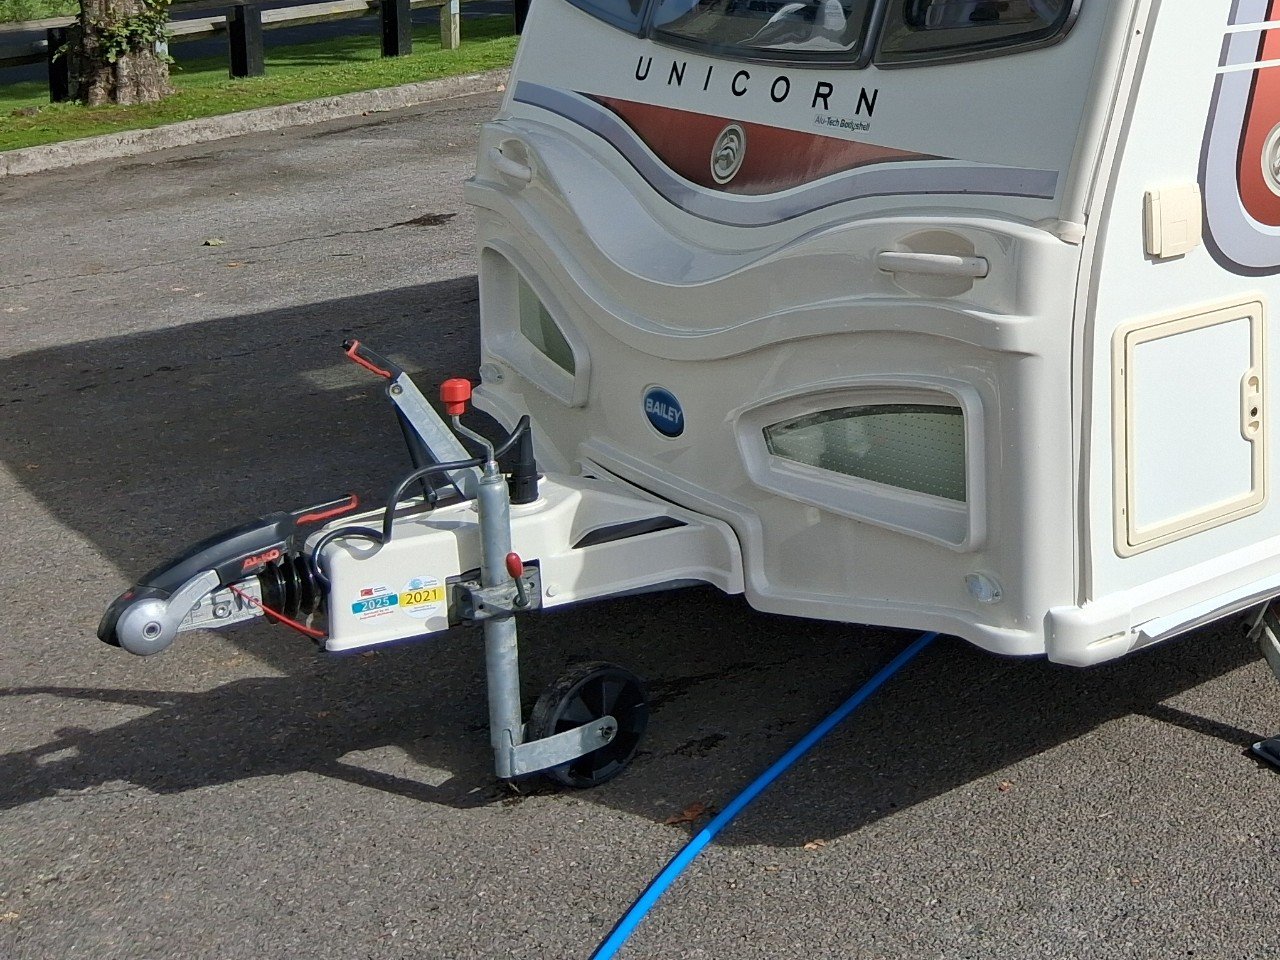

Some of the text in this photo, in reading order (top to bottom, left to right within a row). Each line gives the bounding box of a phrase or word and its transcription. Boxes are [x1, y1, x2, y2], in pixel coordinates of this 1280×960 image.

[635, 56, 879, 117] UNICORN
[815, 115, 840, 127] Alu-Tech
[645, 398, 681, 424] BAILEY
[361, 596, 390, 612] 2025
[405, 589, 437, 605] 2021
